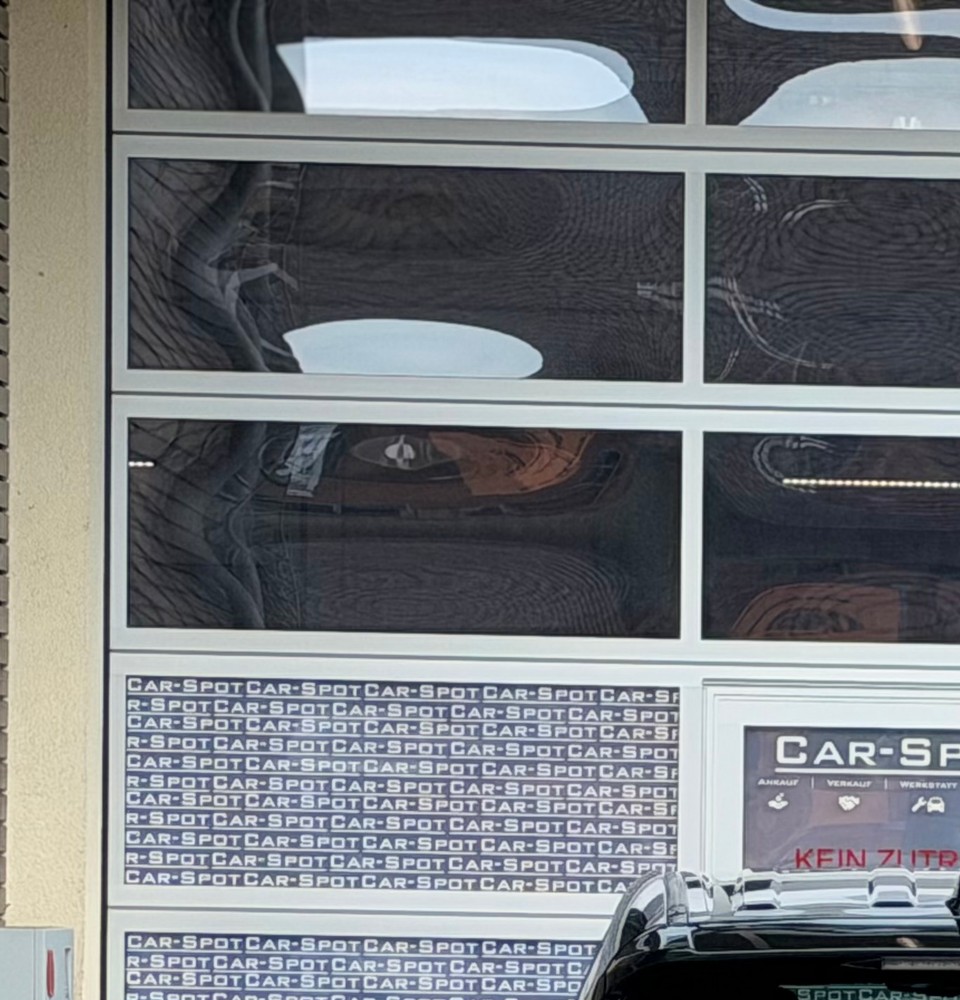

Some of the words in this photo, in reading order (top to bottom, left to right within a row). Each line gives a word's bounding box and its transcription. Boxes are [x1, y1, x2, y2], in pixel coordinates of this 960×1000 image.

[128, 679, 242, 693] CAR-SPOT
[246, 681, 361, 696] CAR-SPOT
[364, 684, 478, 698] CAR-SPOT
[482, 686, 596, 701] CAR-SPOT
[214, 700, 328, 715] CAR-SPOT
[332, 702, 447, 717] CAR-SPOT
[450, 705, 565, 720] CAR-SPOT
[128, 716, 242, 730] CAR-SPOT
[245, 718, 360, 733] CAR-SPOT
[364, 721, 478, 735] CAR-SPOT
[482, 723, 595, 737] CAR-SPOT
[213, 737, 328, 752] CAR-SPOT
[331, 739, 446, 754] CAR-SPOT
[450, 742, 564, 756] CAR-SPOT
[128, 755, 241, 770] CAR-SPOT
[245, 757, 360, 772] CAR-SPOT
[363, 760, 477, 774] CAR-SPOT
[481, 762, 594, 776] CAR-SPOT
[213, 776, 327, 791] CAR-SPOT
[331, 779, 446, 793] CAR-SPOT
[449, 781, 563, 795] CAR-SPOT
[128, 792, 241, 806] CAR-SPOT
[244, 794, 359, 809] CAR-SPOT
[363, 797, 476, 811] CAR-SPOT
[481, 799, 594, 813] CAR-SPOT
[212, 813, 327, 828] CAR-SPOT
[330, 816, 445, 830] CAR-SPOT
[449, 818, 563, 832] CAR-SPOT
[127, 832, 241, 846] CAR-SPOT
[244, 834, 359, 848] CAR-SPOT
[362, 836, 476, 850] CAR-SPOT
[480, 838, 593, 852] CAR-SPOT
[212, 853, 327, 867] CAR-SPOT
[330, 855, 445, 869] CAR-SPOT
[448, 857, 562, 871] CAR-SPOT
[794, 848, 866, 869] KEIN
[127, 872, 240, 886] CAR-SPOT
[244, 874, 358, 888] CAR-SPOT
[362, 876, 475, 890] CAR-SPOT
[479, 878, 592, 892] CAR-SPOT
[128, 936, 243, 949] CAR-SPOT
[245, 938, 361, 951] CAR-SPOT
[363, 940, 478, 953] CAR-SPOT
[482, 942, 595, 955] CAR-SPOT
[213, 957, 328, 970] CAR-SPOT
[331, 959, 446, 972] CAR-SPOT
[449, 961, 564, 974] CAR-SPOT
[127, 973, 242, 986] CAR-SPOT
[244, 974, 360, 988] CAR-SPOT
[363, 976, 477, 990] CAR-SPOT
[481, 978, 583, 992] CAR-SPO
